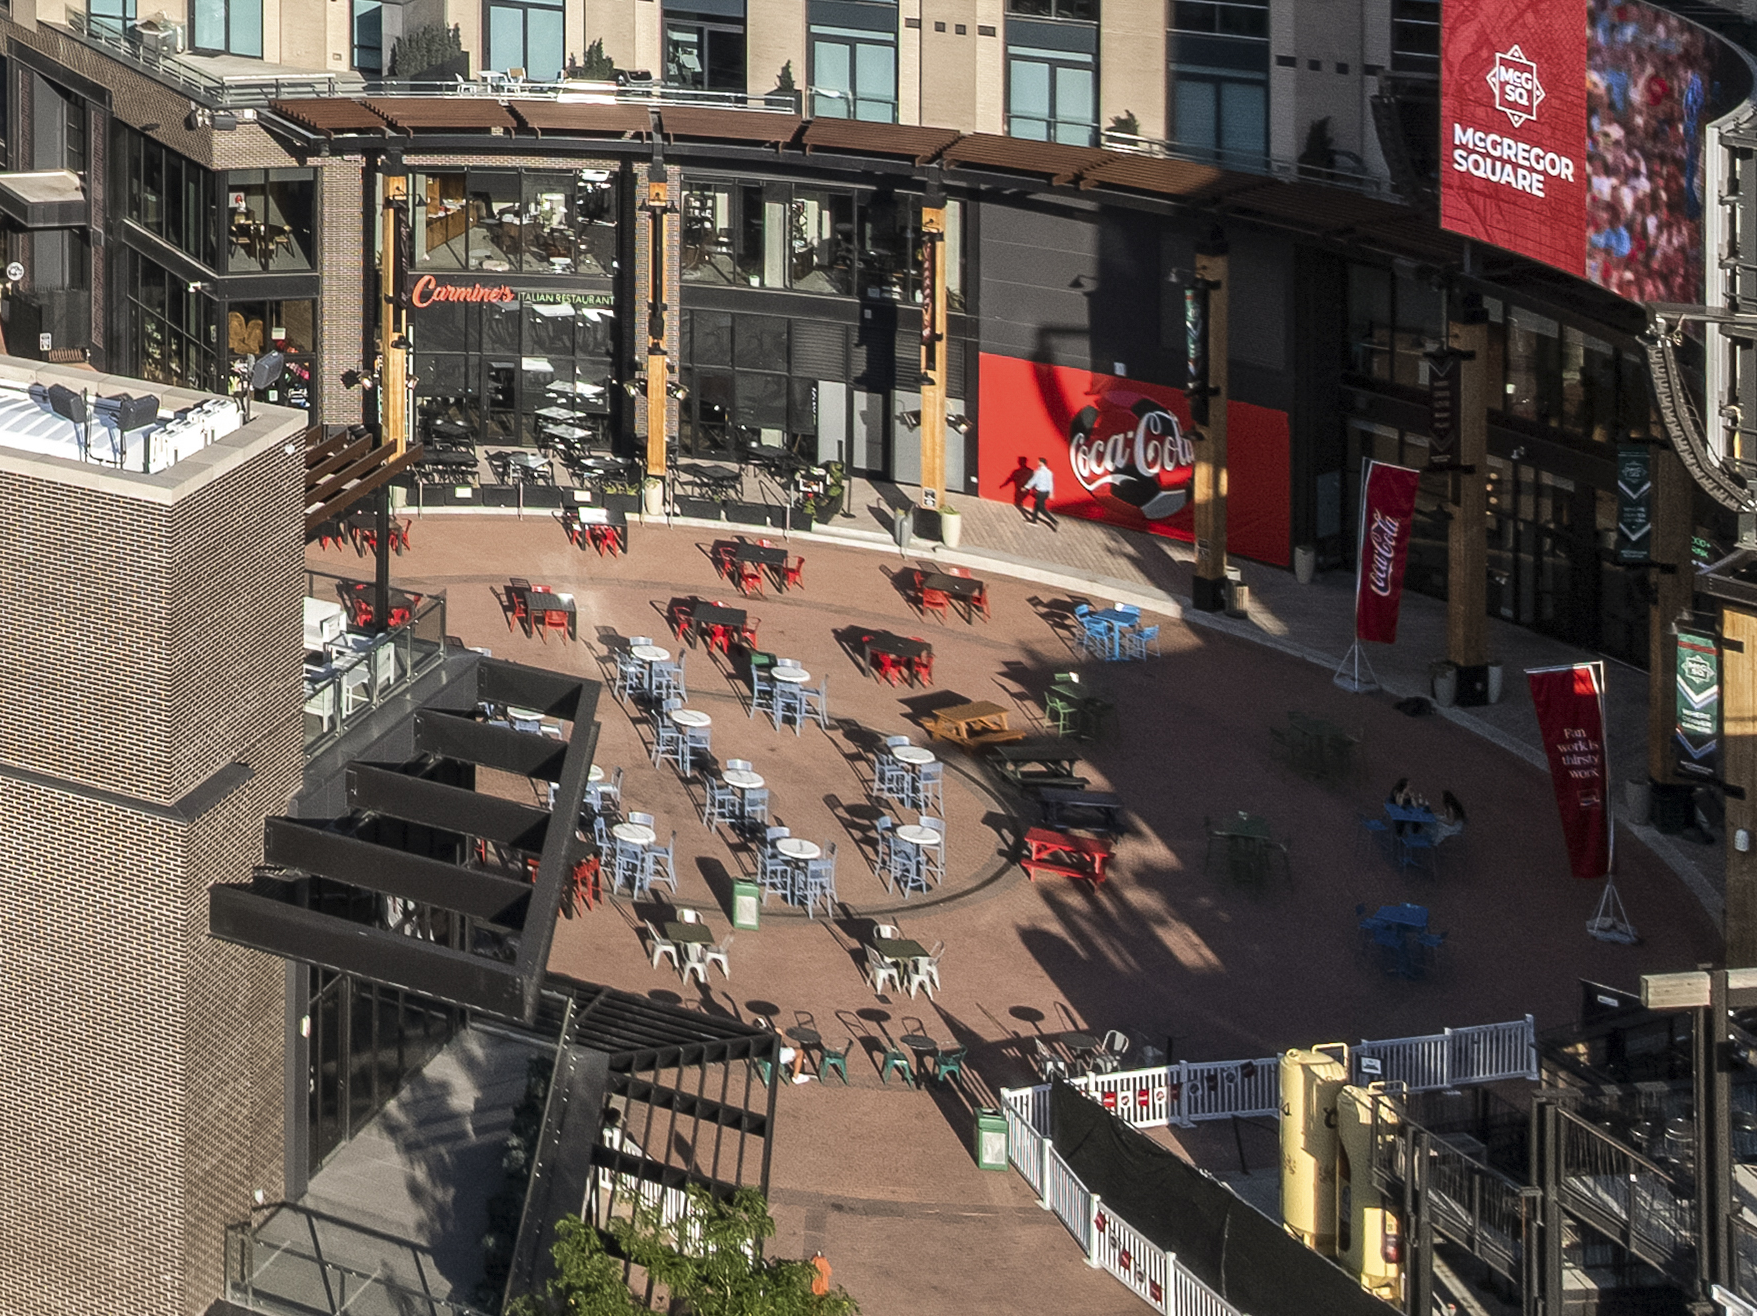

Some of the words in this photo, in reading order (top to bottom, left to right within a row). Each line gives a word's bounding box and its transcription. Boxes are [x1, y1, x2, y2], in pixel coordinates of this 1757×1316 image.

[1499, 66, 1532, 90] McG
[1505, 85, 1529, 106] SQ
[1453, 123, 1575, 183] McGREGOR
[1452, 149, 1545, 198] SQUARE
[412, 274, 515, 309] Carmine's
[518, 291, 554, 303] ITALIAN
[555, 293, 615, 306] RESTAURANT
[1564, 728, 1586, 739] Fan
[1557, 740, 1588, 753] work
[1562, 754, 1599, 766] thirsty
[1569, 768, 1599, 779] work
